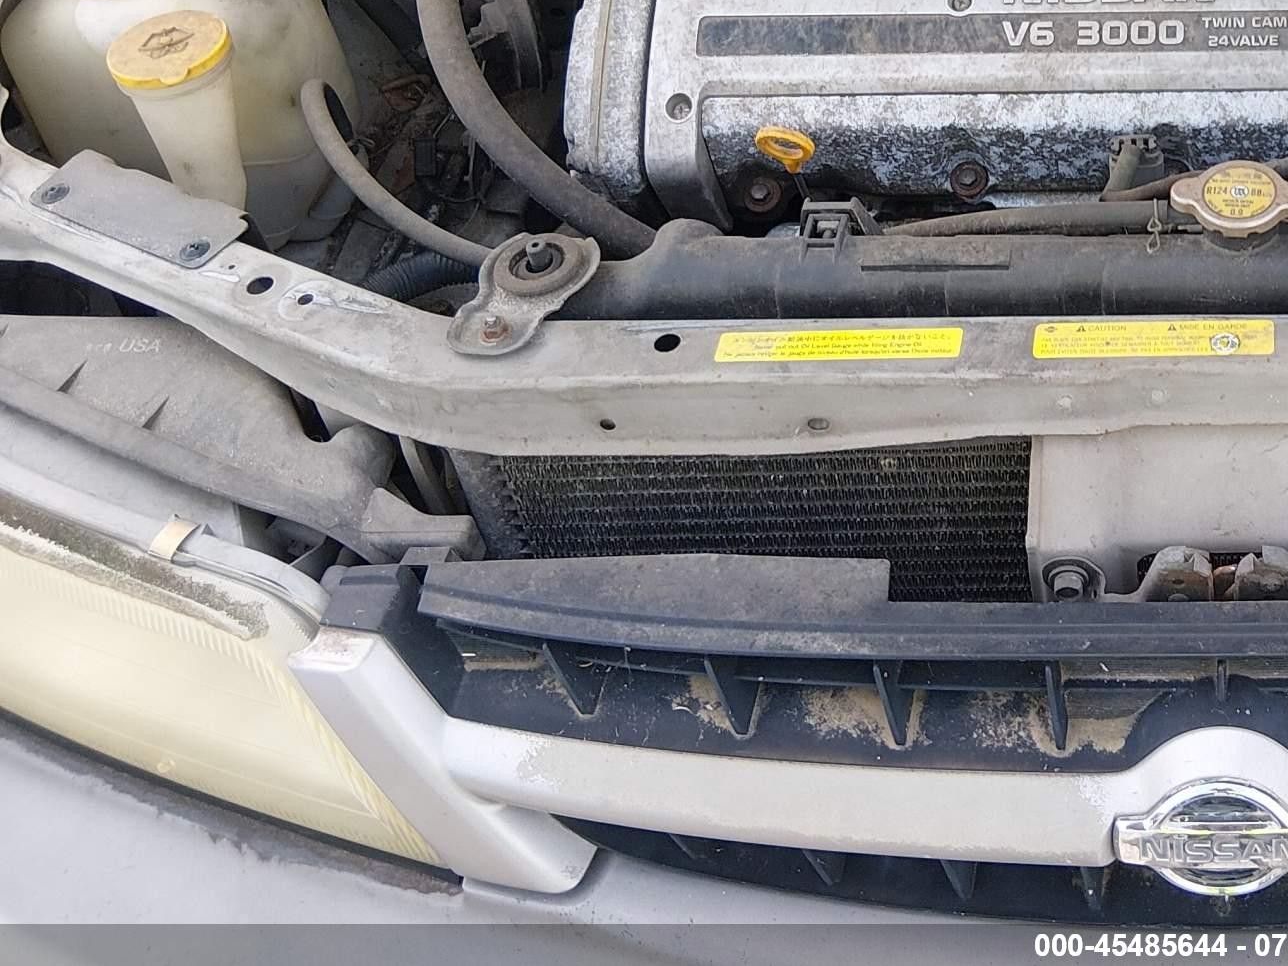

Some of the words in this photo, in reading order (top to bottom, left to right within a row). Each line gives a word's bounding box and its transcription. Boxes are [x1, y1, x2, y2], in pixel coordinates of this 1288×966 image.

[1202, 16, 1246, 28] TWIN
[1251, 15, 1288, 28] CAM
[1002, 21, 1055, 46] V6
[1076, 20, 1185, 46] 3000
[1208, 34, 1279, 47] 24VALVE
[119, 337, 161, 353] USA
